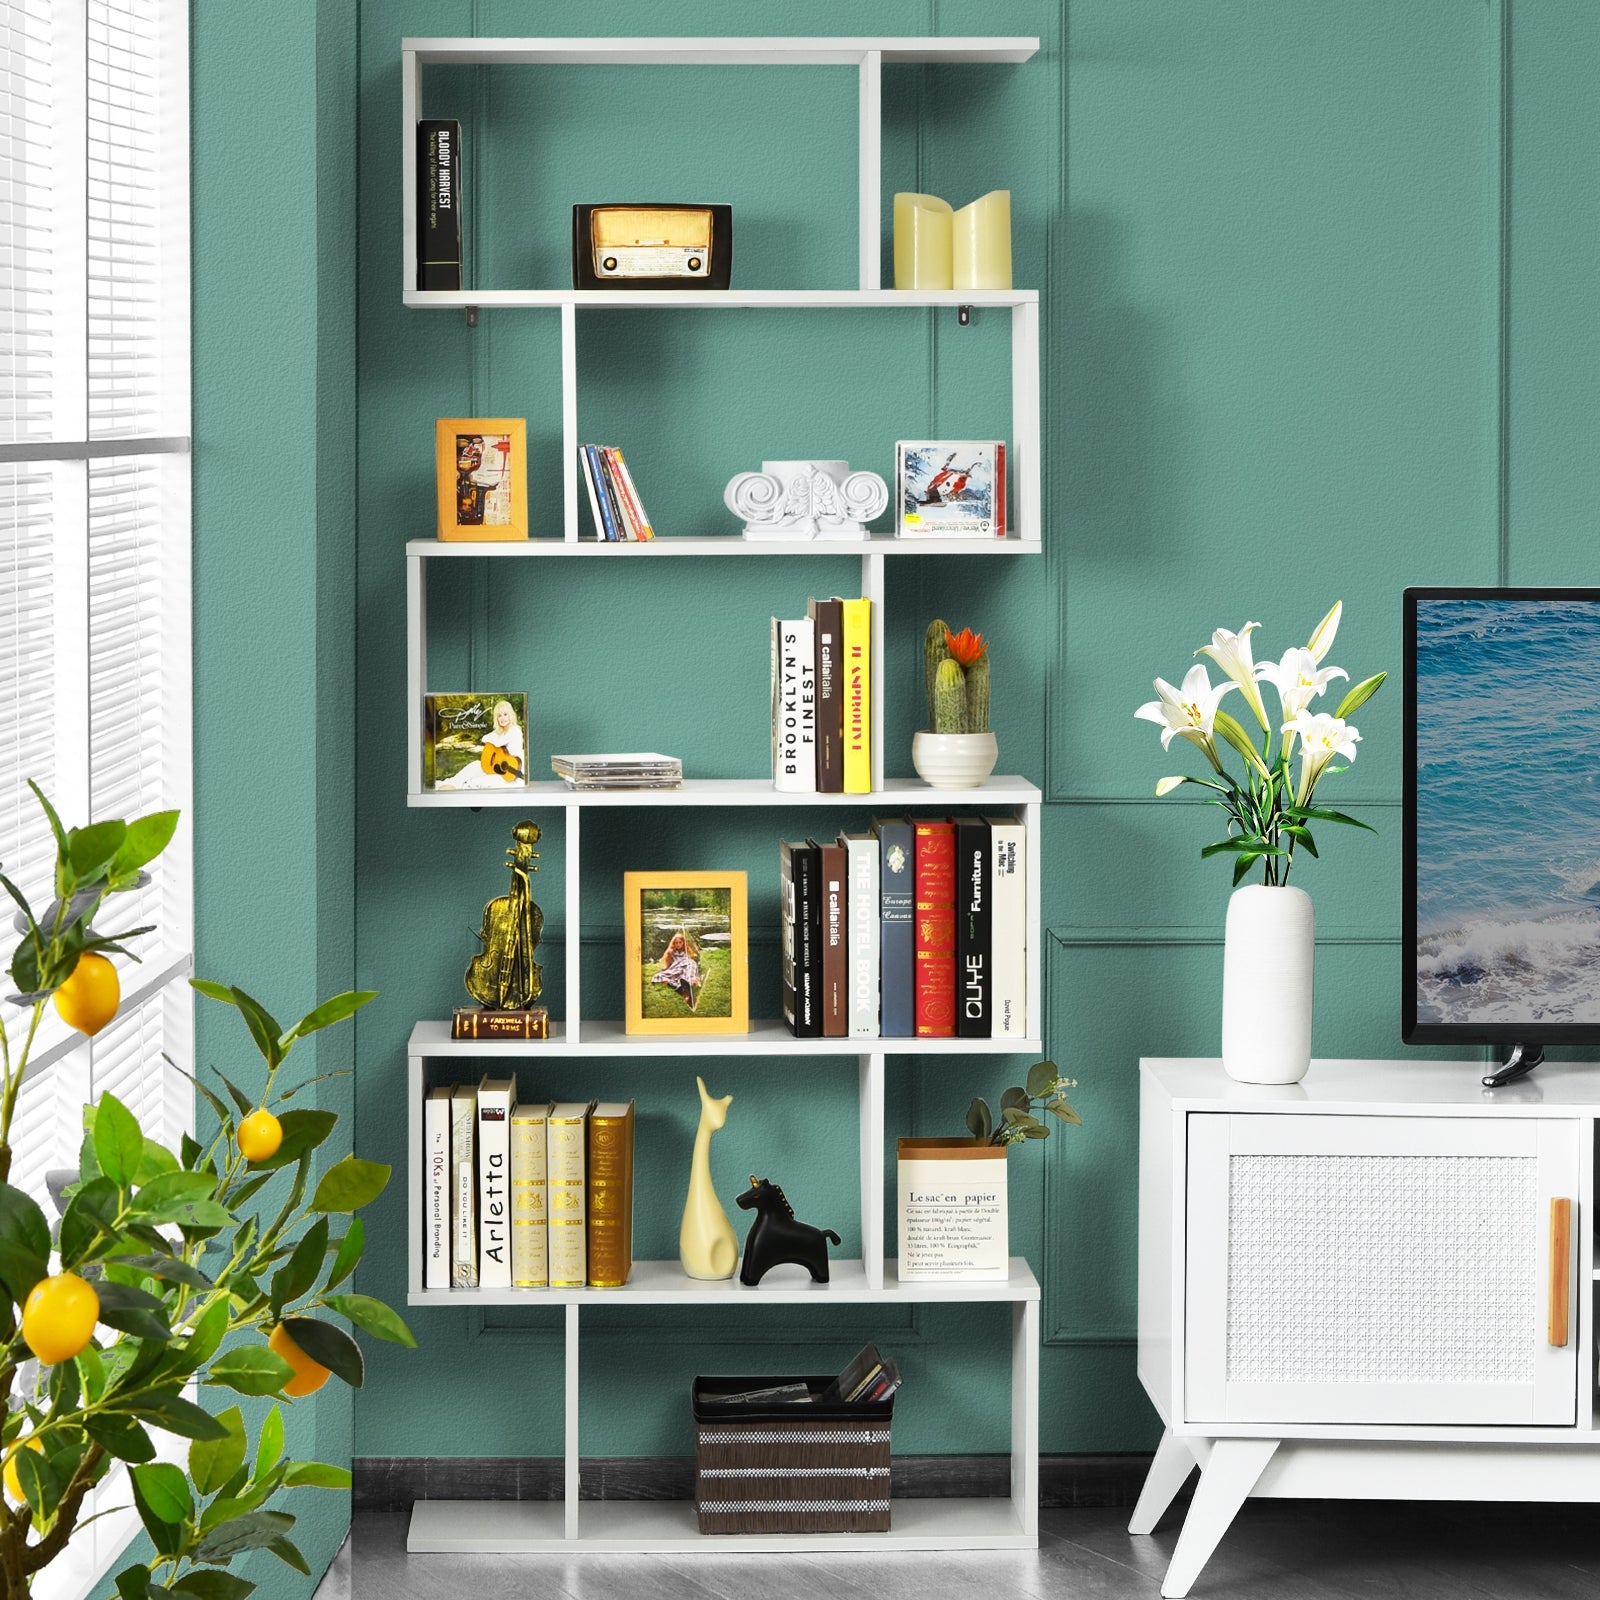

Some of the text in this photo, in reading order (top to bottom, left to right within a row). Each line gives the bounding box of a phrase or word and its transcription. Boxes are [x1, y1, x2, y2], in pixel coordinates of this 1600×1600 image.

[438, 131, 450, 208] BLOODY HARVEST
[785, 634, 796, 774] BROOKLYN'S
[802, 665, 814, 743] FINEST
[856, 852, 871, 889] THE
[998, 854, 1007, 867] Mac
[1006, 842, 1016, 874] Switching
[971, 850, 982, 912] Furniture
[856, 894, 871, 955] HOTEL
[856, 960, 871, 1012] BOOK
[1003, 1015, 1011, 1031] Pogue
[433, 1150, 444, 1176] 10Ks
[462, 1176, 468, 1189] DO
[910, 1192, 923, 1202] Le
[965, 1192, 996, 1205] papier
[484, 1153, 504, 1264] Arletta
[433, 1223, 442, 1258] Branding
